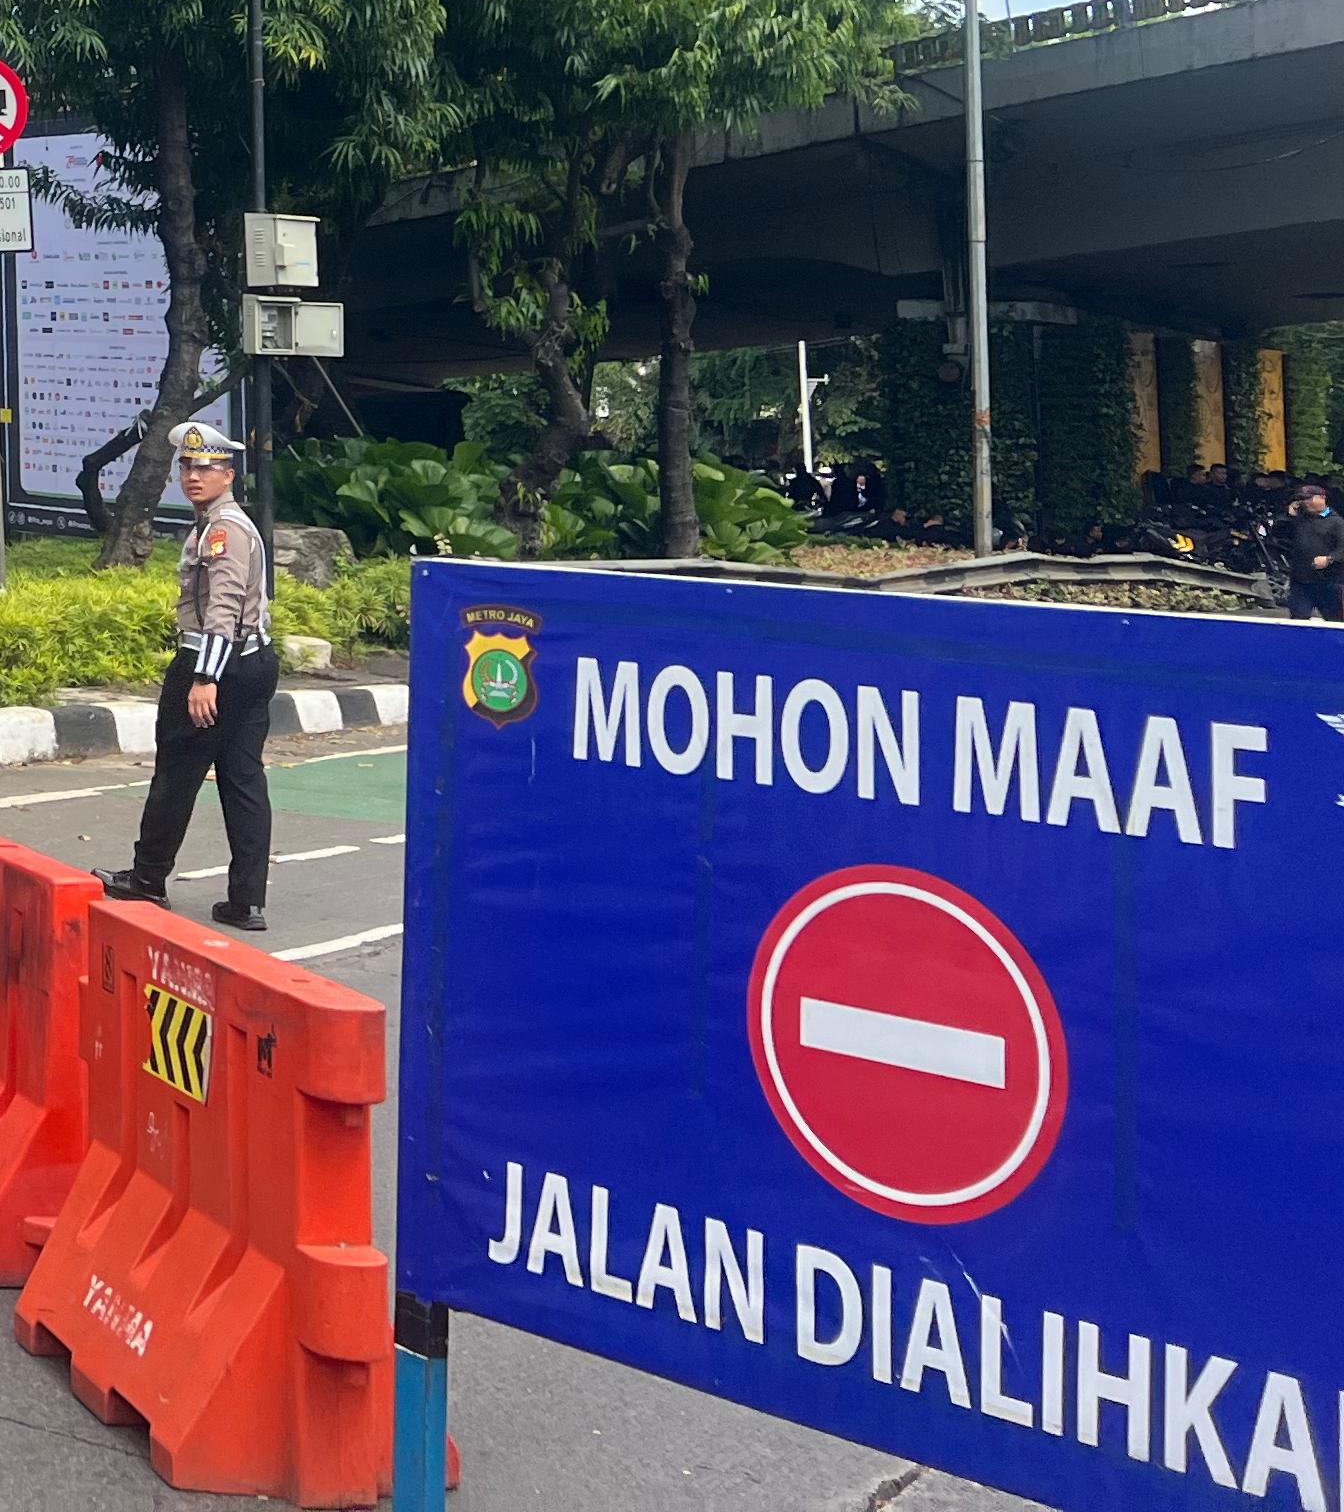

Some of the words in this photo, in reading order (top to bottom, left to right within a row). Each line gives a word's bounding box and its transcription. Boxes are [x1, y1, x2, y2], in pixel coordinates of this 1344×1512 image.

[466, 610, 505, 623] METRO
[507, 613, 535, 628] JAYA
[573, 657, 920, 807] MOHON
[953, 695, 1269, 850] MAAF
[488, 1161, 765, 1344] JALAN
[796, 1244, 1344, 1512] DIALIHKA
